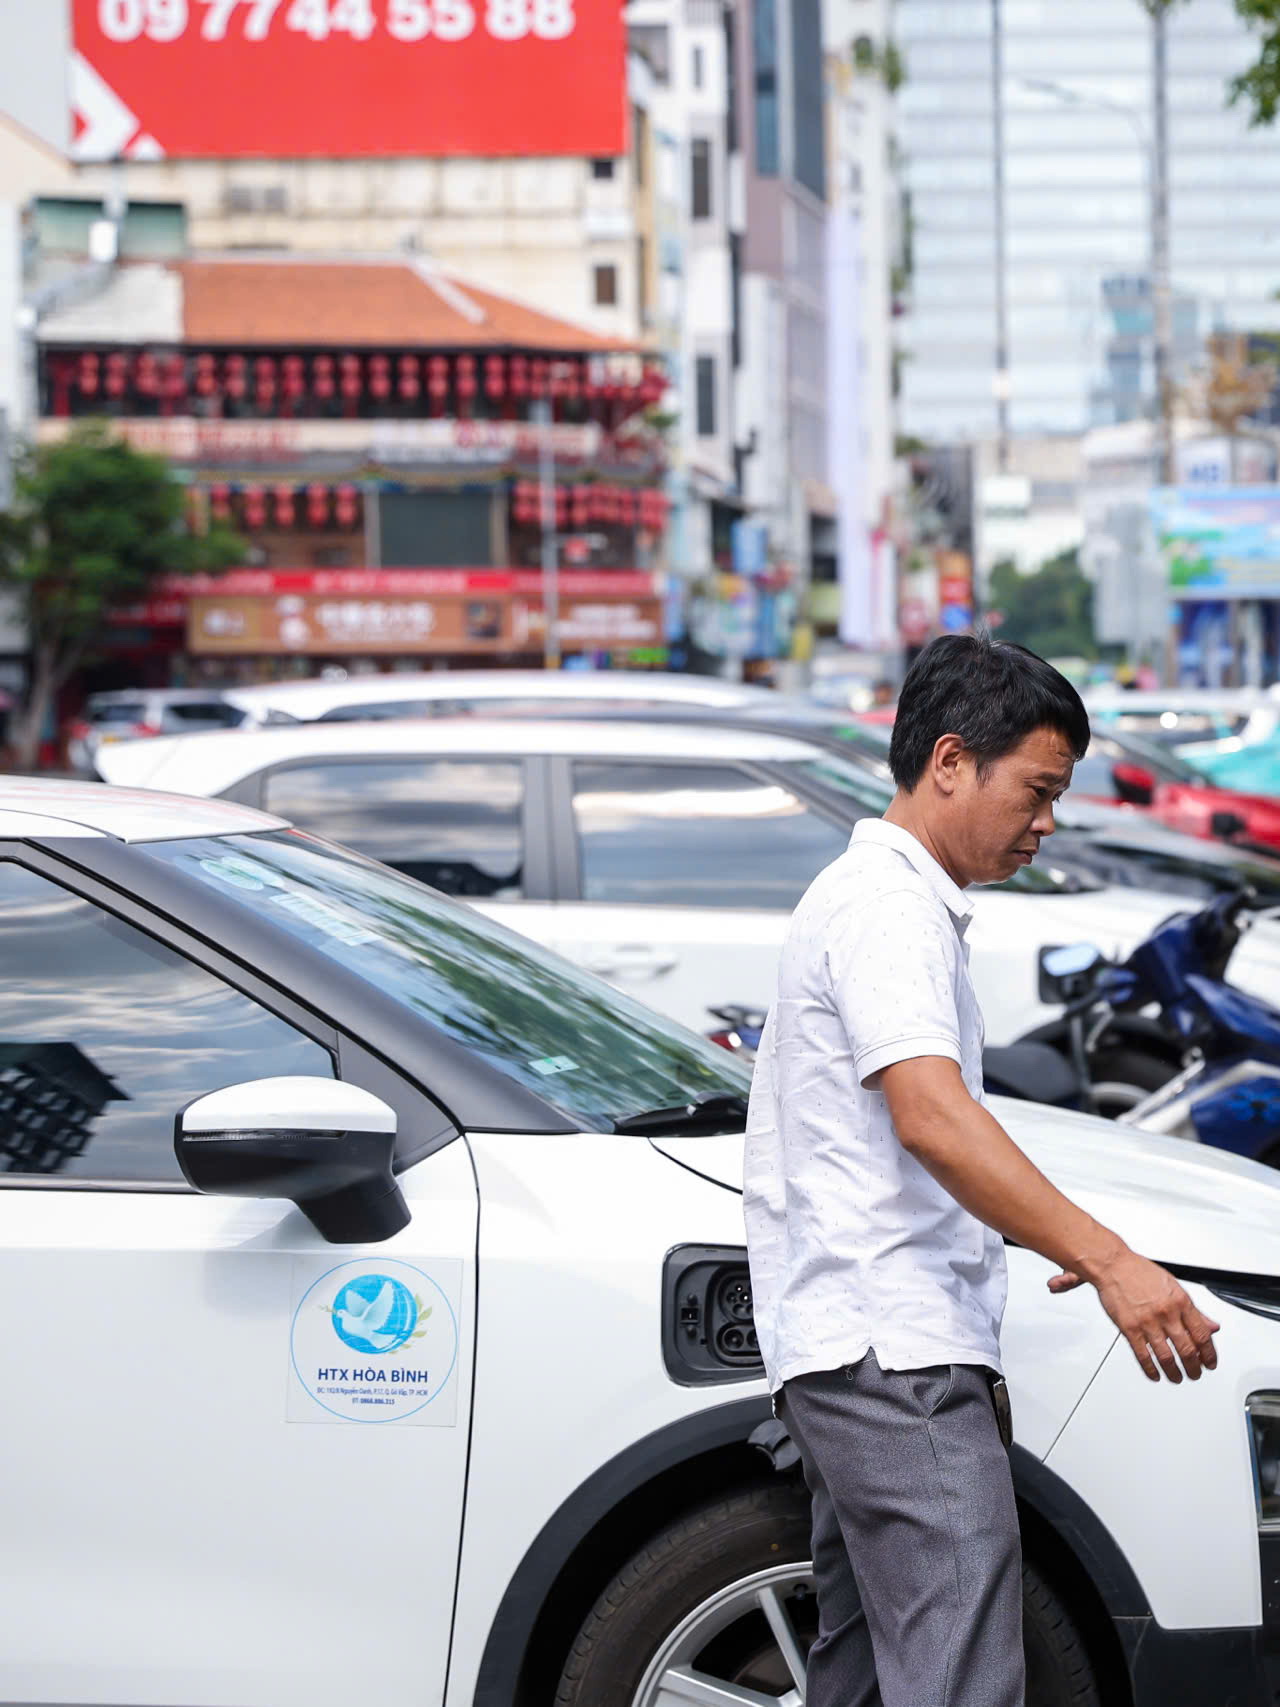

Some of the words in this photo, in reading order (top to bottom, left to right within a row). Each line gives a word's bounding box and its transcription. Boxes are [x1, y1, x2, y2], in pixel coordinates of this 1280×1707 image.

[318, 1368, 349, 1381] HTX
[353, 1366, 387, 1383] HÒA
[391, 1368, 428, 1383] BÌNH
